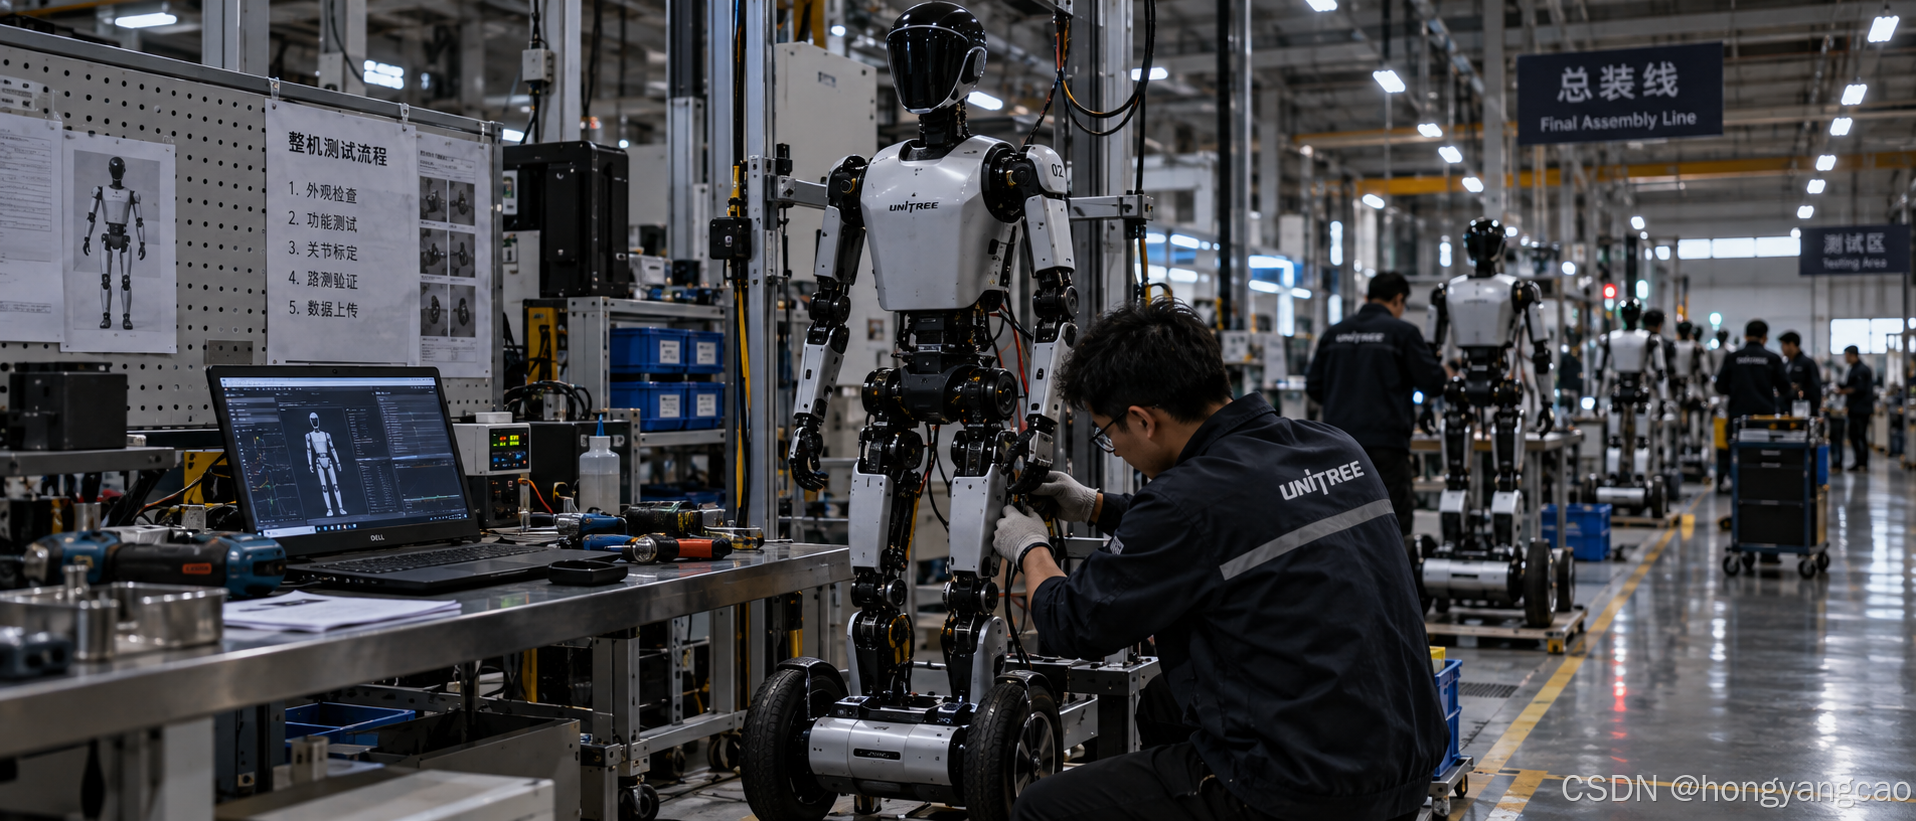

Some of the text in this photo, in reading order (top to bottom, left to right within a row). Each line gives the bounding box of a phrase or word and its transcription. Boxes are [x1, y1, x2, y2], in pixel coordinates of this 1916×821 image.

[1557, 61, 1679, 103] 总装线
[1540, 110, 1697, 132] Final Assembly Line
[288, 131, 388, 166] 整机测试流程
[1051, 163, 1065, 178] 02
[288, 181, 357, 204] 1. 外观检查
[288, 210, 358, 233] 2. 功能测试
[288, 240, 358, 261] 3. 关节标定
[1823, 232, 1886, 255] 测试区
[288, 270, 358, 290] 4. 路测验证
[289, 300, 359, 318] 5. 数据上传
[370, 534, 386, 542] DELL
